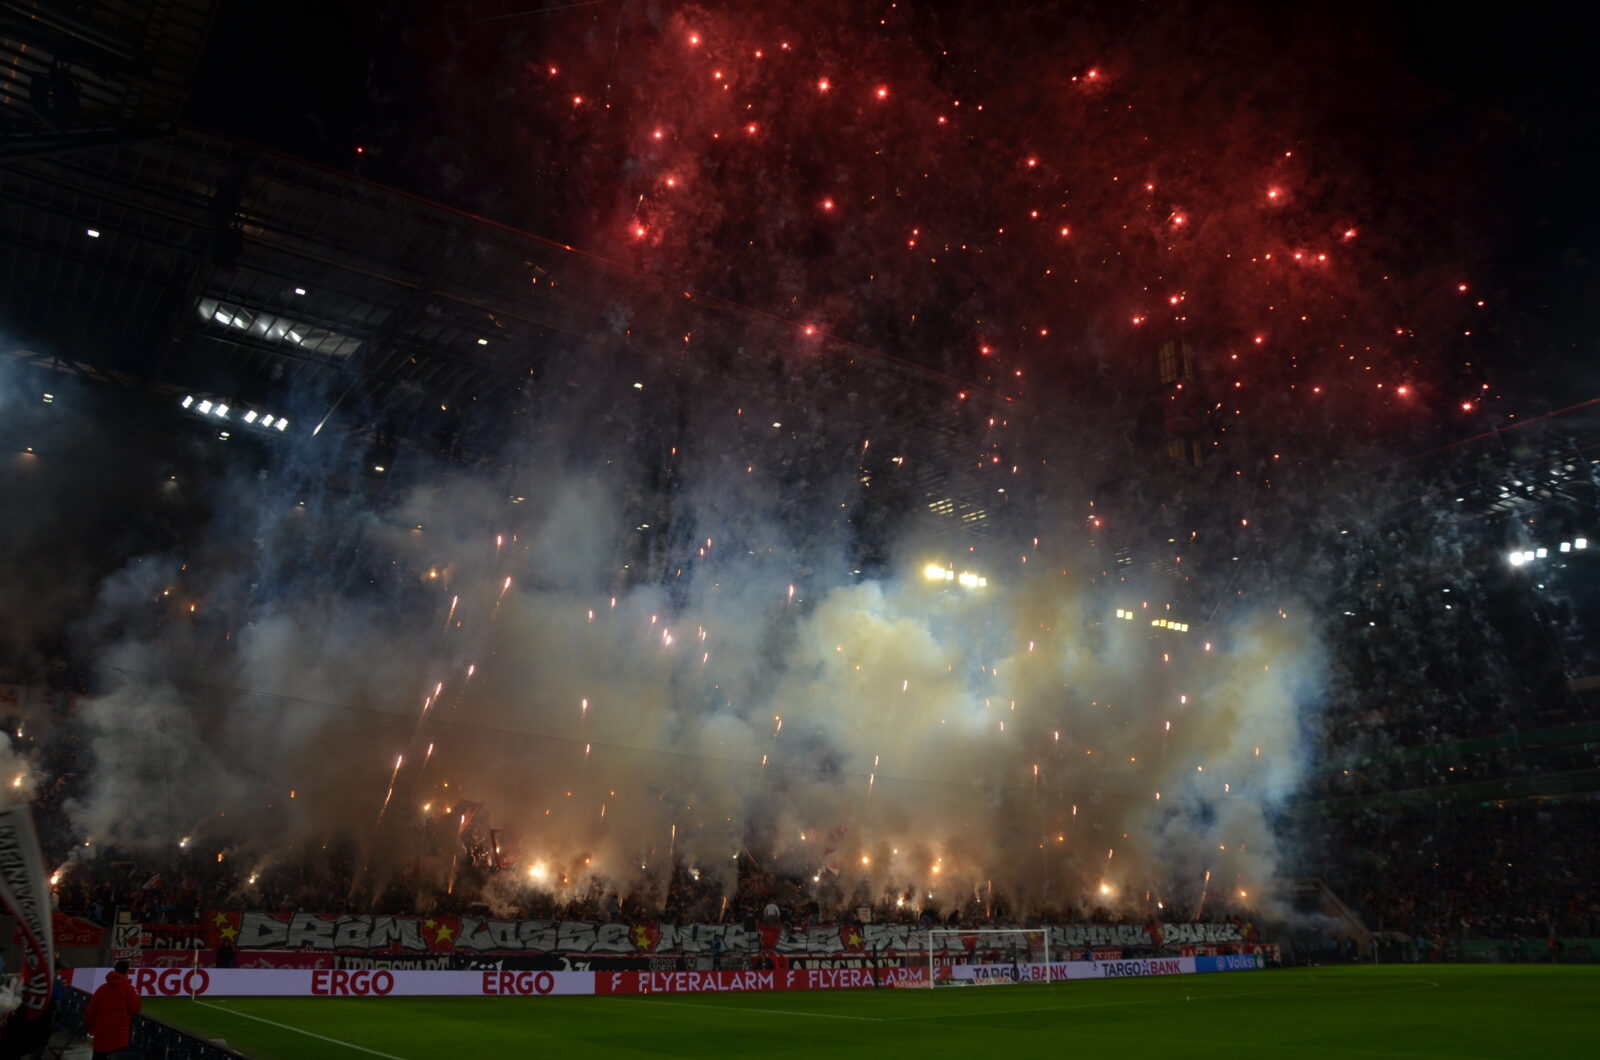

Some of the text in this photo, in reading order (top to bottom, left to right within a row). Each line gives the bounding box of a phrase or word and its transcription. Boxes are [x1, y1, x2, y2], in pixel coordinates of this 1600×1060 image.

[454, 917, 638, 953] LOSSE
[312, 970, 394, 995] ERGO
[482, 971, 555, 994] ERGO
[638, 970, 774, 992] FLYERALARM
